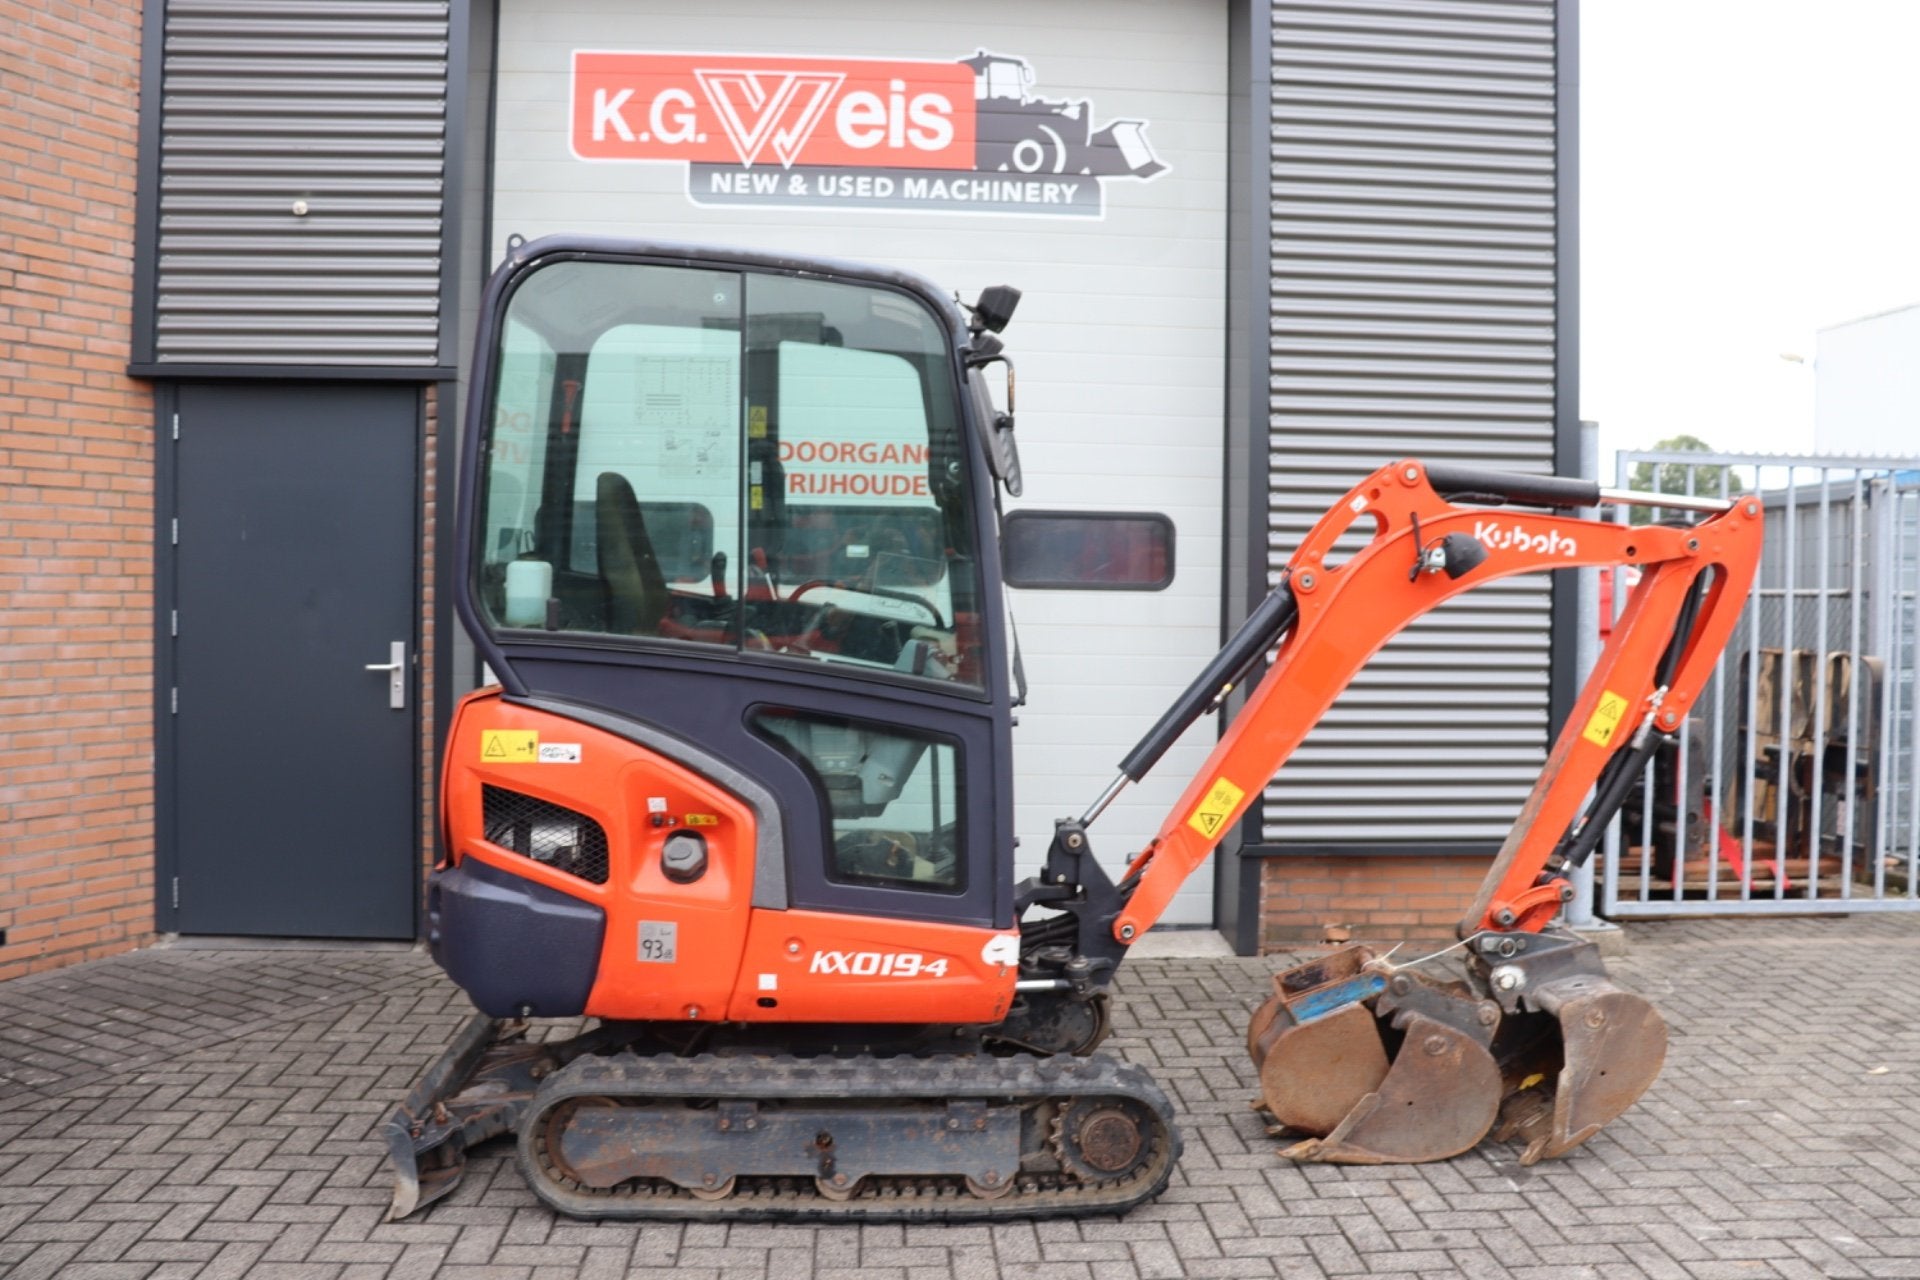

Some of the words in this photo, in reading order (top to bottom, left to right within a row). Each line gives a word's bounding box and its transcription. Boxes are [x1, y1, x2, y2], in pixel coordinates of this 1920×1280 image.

[711, 172, 780, 195] NEW
[787, 174, 808, 196] &
[817, 174, 895, 198] USED
[903, 177, 1079, 204] MACHINERY
[778, 441, 932, 465] DOORGAN
[785, 472, 935, 496] RIJHOUDE
[1474, 520, 1577, 557] Kubota
[642, 939, 663, 960] 93
[809, 950, 948, 978] KX019-4
